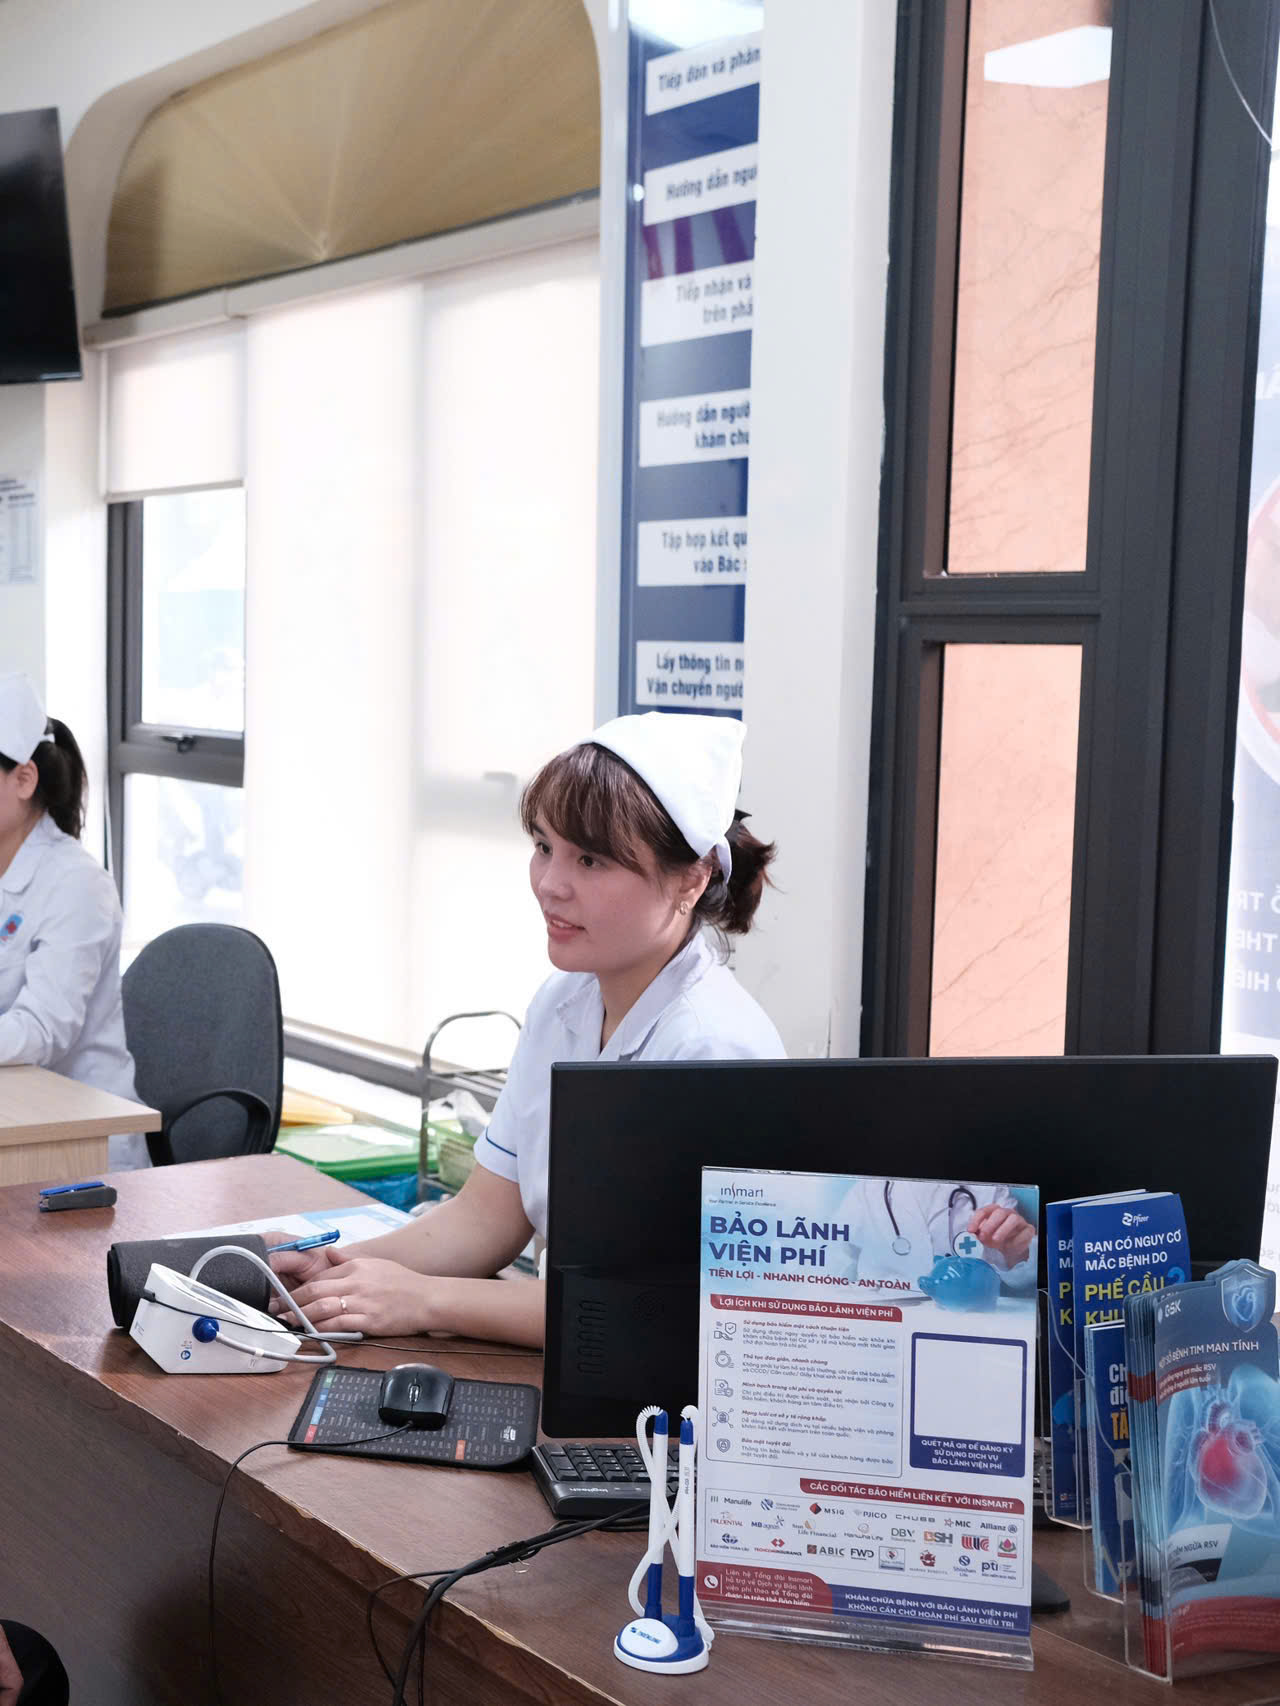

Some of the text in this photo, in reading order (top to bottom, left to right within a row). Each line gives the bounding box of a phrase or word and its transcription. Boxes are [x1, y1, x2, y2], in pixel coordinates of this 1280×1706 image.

[715, 654, 731, 671] tin
[710, 1211, 850, 1242] BẢO LÃNH
[1132, 1214, 1149, 1227] Pfizer
[1085, 1229, 1181, 1255] BẠN CÓ NGUY CƠ
[709, 1240, 826, 1267] VIỆN PHÍ
[1085, 1253, 1116, 1271] MẮC
[1119, 1253, 1150, 1270] BỆNH
[1152, 1251, 1168, 1264] DO
[709, 1267, 911, 1290] TIỆN LỢI NHANH CHÓNG AN TOÀN
[1085, 1274, 1124, 1301] PHẾ
[1128, 1271, 1165, 1296] CẦU
[720, 1298, 893, 1318] LỢI ÍCH KHI SỬ DỤNG BẢO LÃNH VIỆN PHÍ
[1190, 1344, 1204, 1355] TIM
[1206, 1342, 1230, 1355] MẠN
[1232, 1338, 1259, 1351] TÍNH
[1203, 1363, 1217, 1371] RSV
[921, 1439, 941, 1447] QUÉT
[968, 1442, 979, 1450] ĐỂ
[980, 1444, 1001, 1452] ĐĂNG
[932, 1456, 1002, 1470] BẢO LÃNH VIỆN PHÍ
[946, 1450, 967, 1459] DỤNG
[968, 1452, 986, 1460] DỊCH
[988, 1454, 999, 1462] VỤ
[810, 1481, 1014, 1509] CÁC ĐỐI TÁC BẢO HIỂM LIÊN KẾT VỚI INSMART
[724, 1497, 752, 1506] Manulife
[863, 1511, 887, 1519] PJICO
[895, 1514, 935, 1523] CHUBB
[955, 1520, 971, 1528] MIC
[980, 1522, 1006, 1531] Allianz
[819, 1546, 845, 1556] ABIC
[850, 1548, 874, 1558] FWD
[1204, 1540, 1218, 1548] RSV
[845, 1592, 1018, 1619] KHÁM CHỮA BỆNH VỚI BẢO LÃNH VIỆN PHÍ
[848, 1602, 878, 1612] KHÔNG
[879, 1605, 897, 1614] CẦN
[898, 1608, 916, 1617] CHỜ
[918, 1611, 942, 1619] HOÀN
[944, 1613, 959, 1621] PHÍ
[979, 1617, 999, 1626] ĐIỀU
[1001, 1621, 1014, 1629] TRỊ
